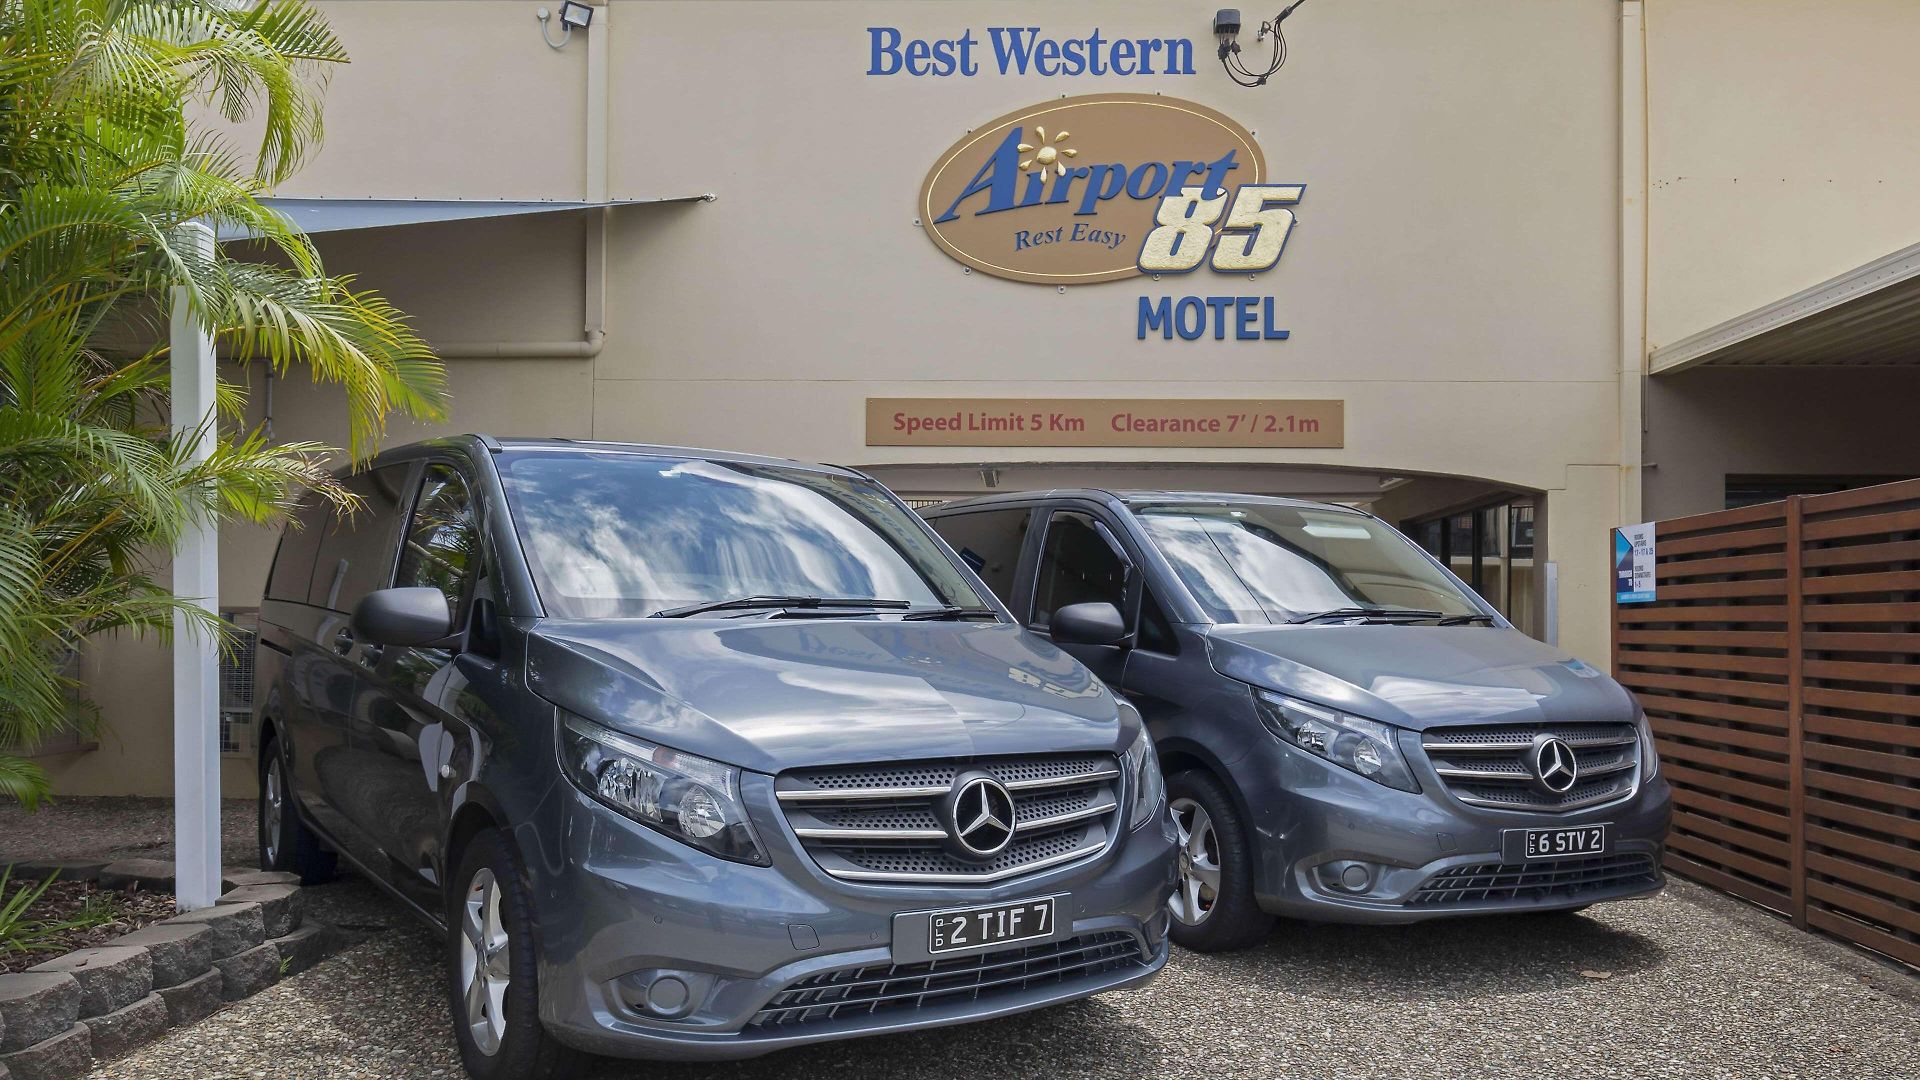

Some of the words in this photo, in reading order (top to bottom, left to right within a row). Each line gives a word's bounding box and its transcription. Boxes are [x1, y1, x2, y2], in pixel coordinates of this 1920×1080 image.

[866, 27, 978, 76] Best
[987, 27, 1197, 76] Western
[932, 126, 1240, 224] Airport
[1014, 226, 1064, 252] Rest
[1069, 223, 1127, 250] Easy
[1136, 184, 1308, 274] 85
[1137, 295, 1290, 341] MOTEL
[893, 412, 962, 435] Speed
[968, 412, 1025, 431] Limit
[1030, 413, 1043, 431] 5
[1049, 413, 1085, 432] Km
[1111, 413, 1221, 433] Clearance
[1250, 414, 1259, 433] /
[1263, 414, 1320, 433] 2.1m
[1539, 833, 1550, 853] 6
[1555, 830, 1586, 852] STV
[1590, 829, 1600, 849] 2
[935, 918, 944, 947] QLD
[951, 916, 967, 945] 2
[977, 907, 1025, 940] TIF
[1033, 904, 1048, 931] 7
